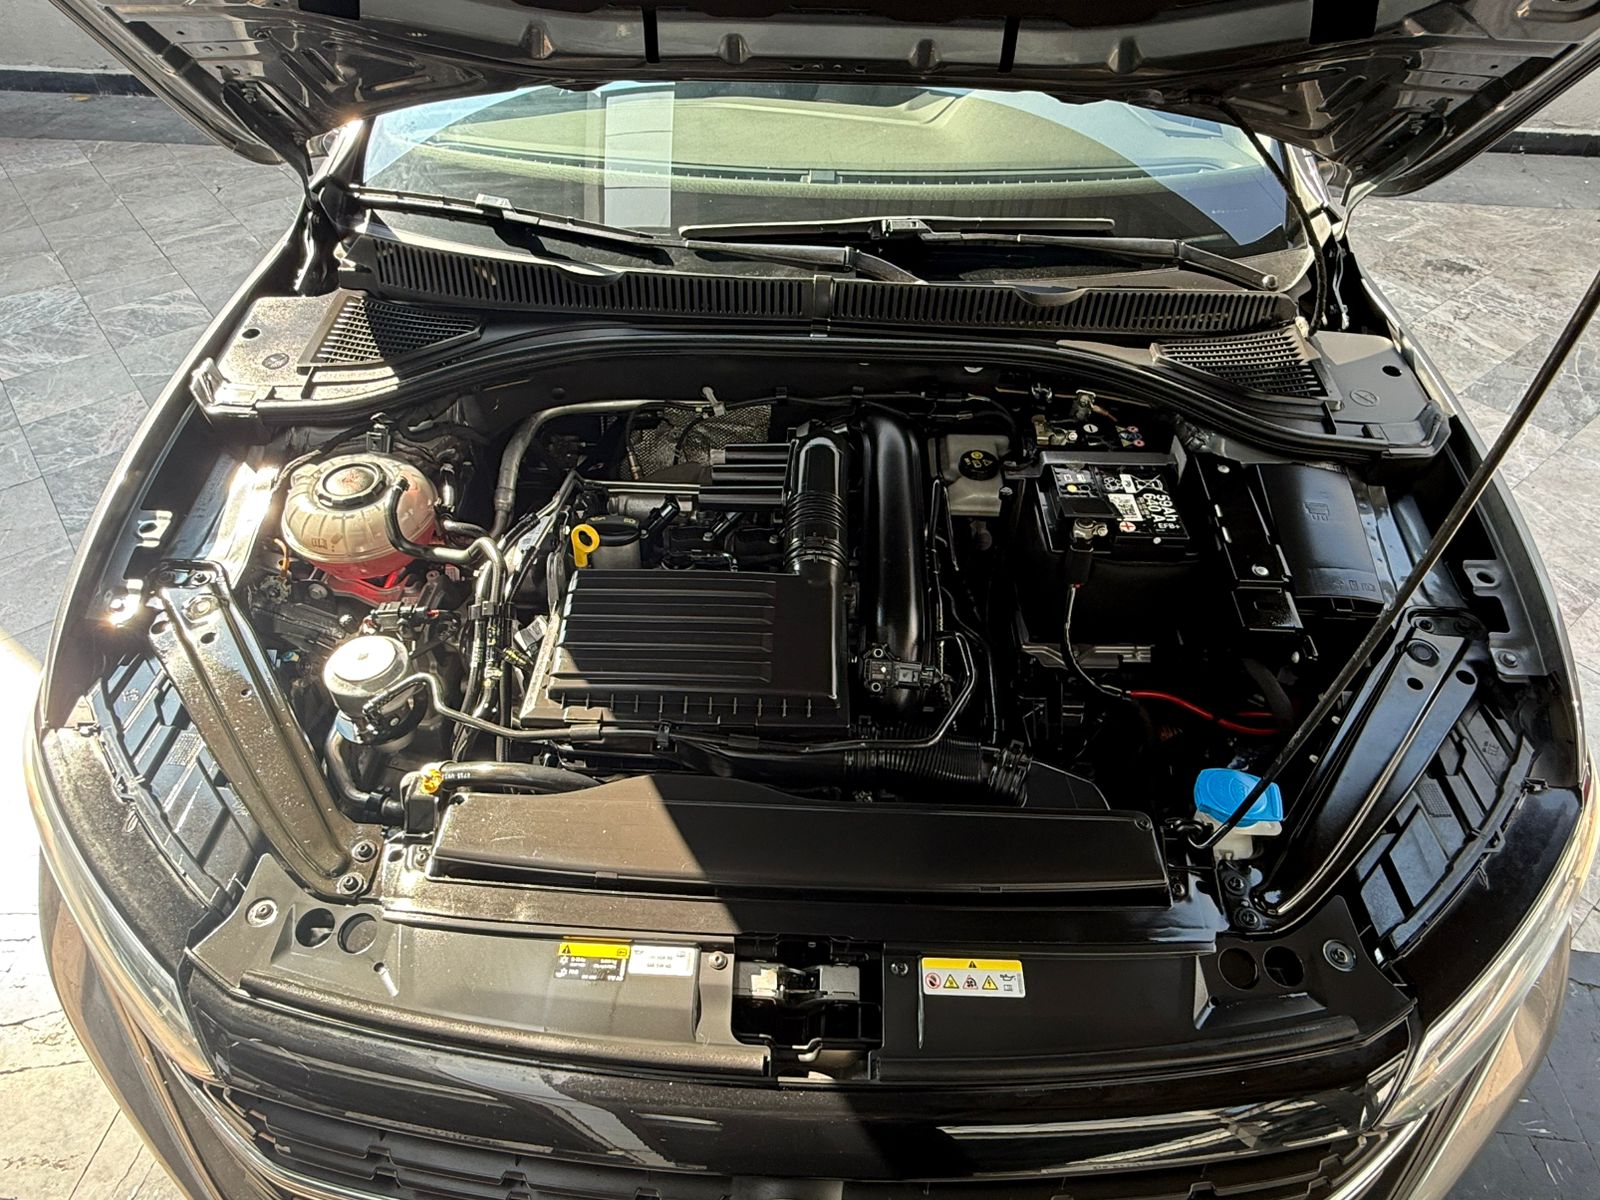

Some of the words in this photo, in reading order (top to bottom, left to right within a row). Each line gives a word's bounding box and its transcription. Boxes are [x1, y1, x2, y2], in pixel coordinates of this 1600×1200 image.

[1143, 493, 1161, 512] 640
[1156, 494, 1179, 521] 59Ah
[1151, 513, 1166, 523] A
